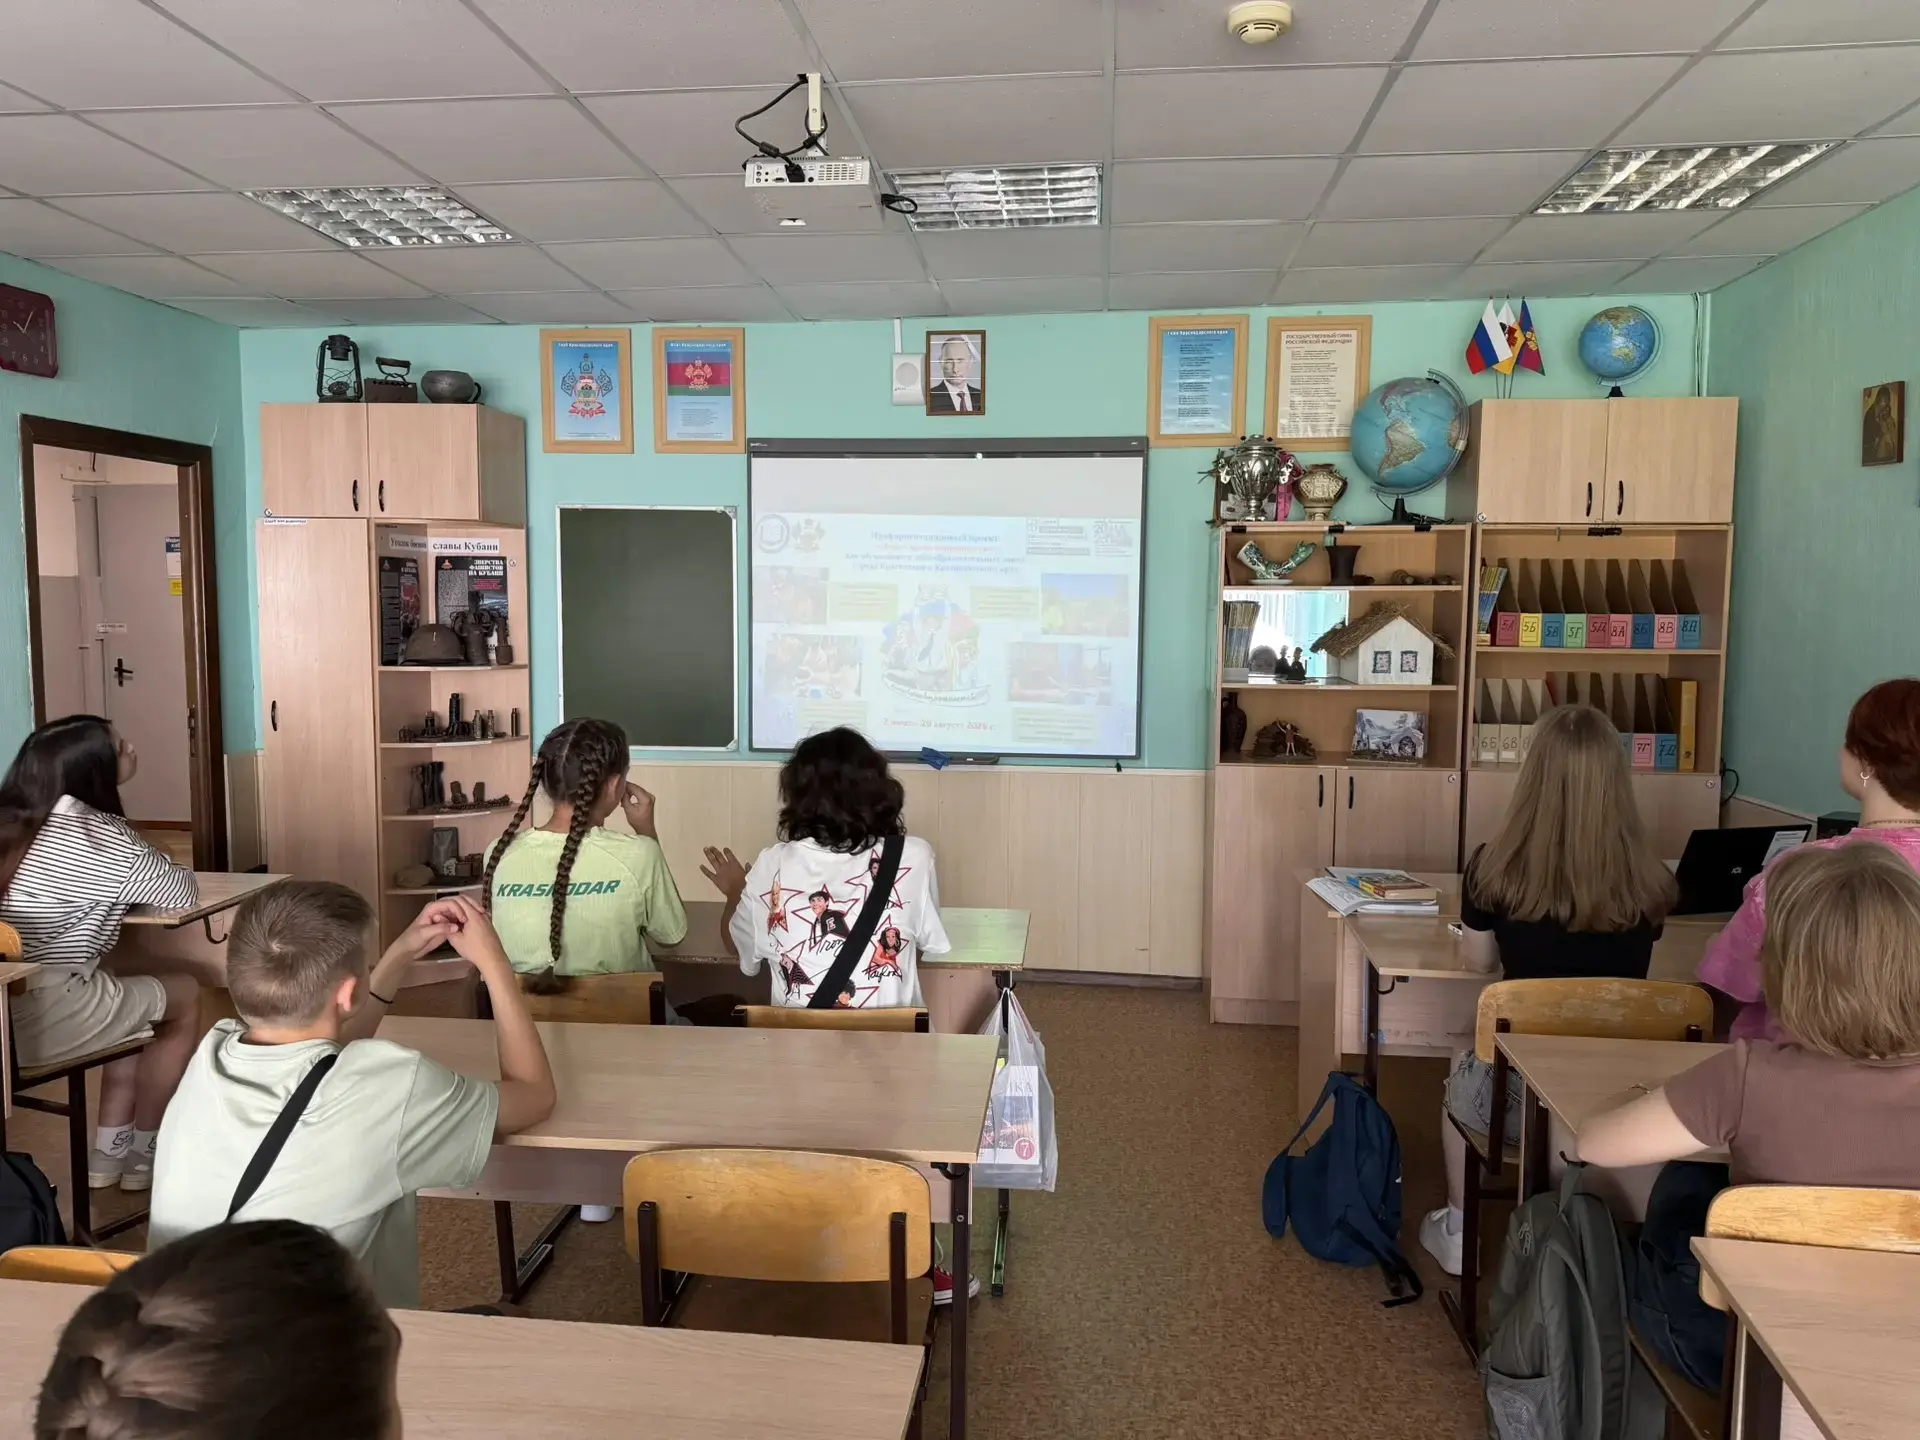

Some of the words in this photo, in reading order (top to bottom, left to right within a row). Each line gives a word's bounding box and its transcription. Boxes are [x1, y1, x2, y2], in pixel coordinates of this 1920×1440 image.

[463, 541, 498, 553] Кубани
[1658, 620, 1674, 633] 8В
[497, 880, 621, 898] KRASODAR
[1020, 1141, 1030, 1158] 7
